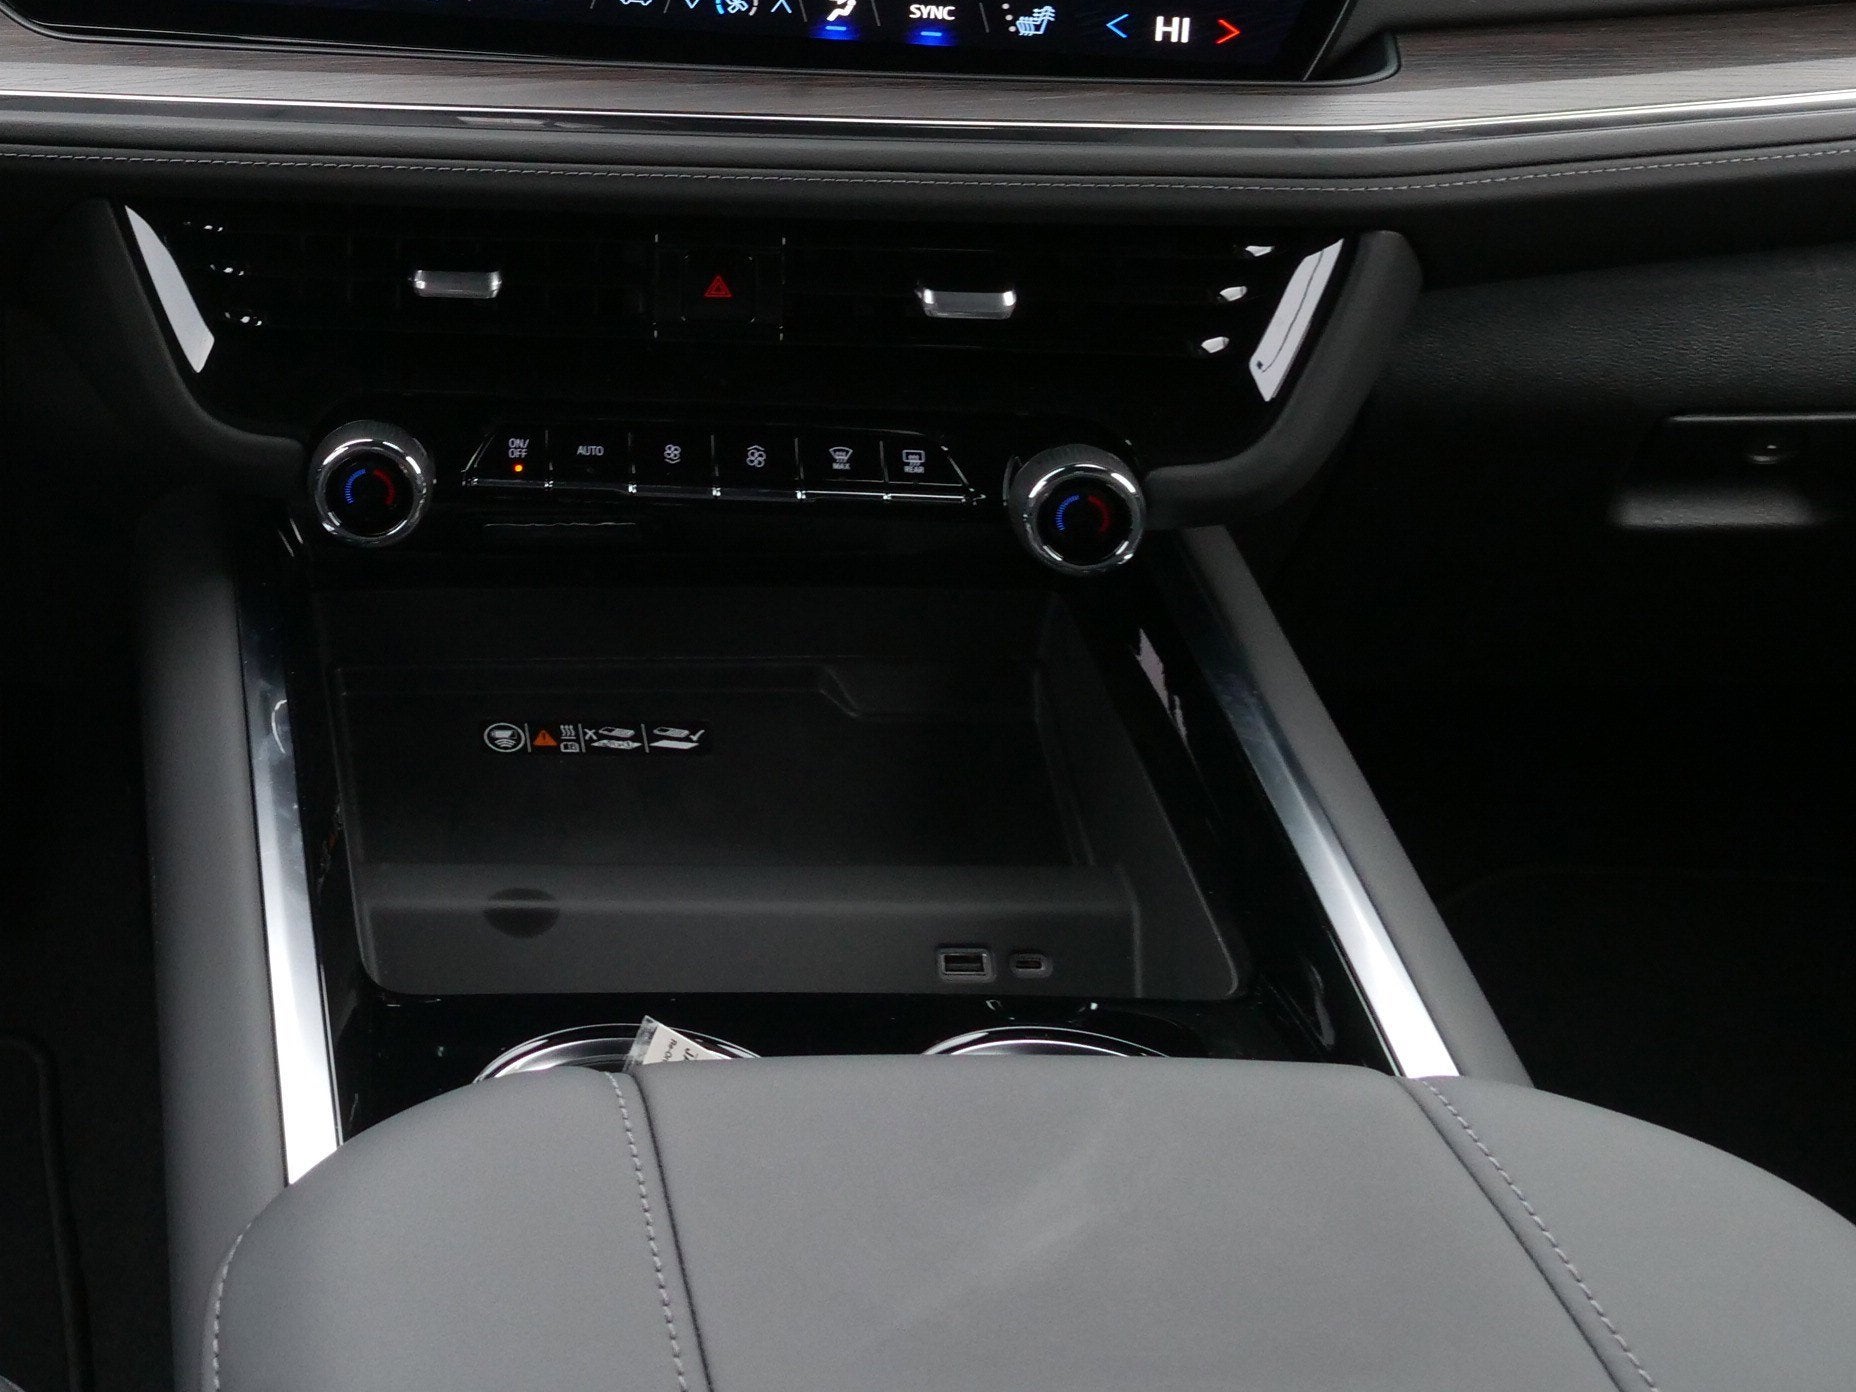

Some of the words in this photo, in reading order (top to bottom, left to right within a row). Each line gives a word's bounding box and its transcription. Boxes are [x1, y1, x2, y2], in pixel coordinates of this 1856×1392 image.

[909, 3, 956, 21] SYNC
[1154, 15, 1191, 44] HI
[508, 437, 530, 449] ON/
[508, 448, 528, 459] OFF
[576, 445, 605, 456] AUTO
